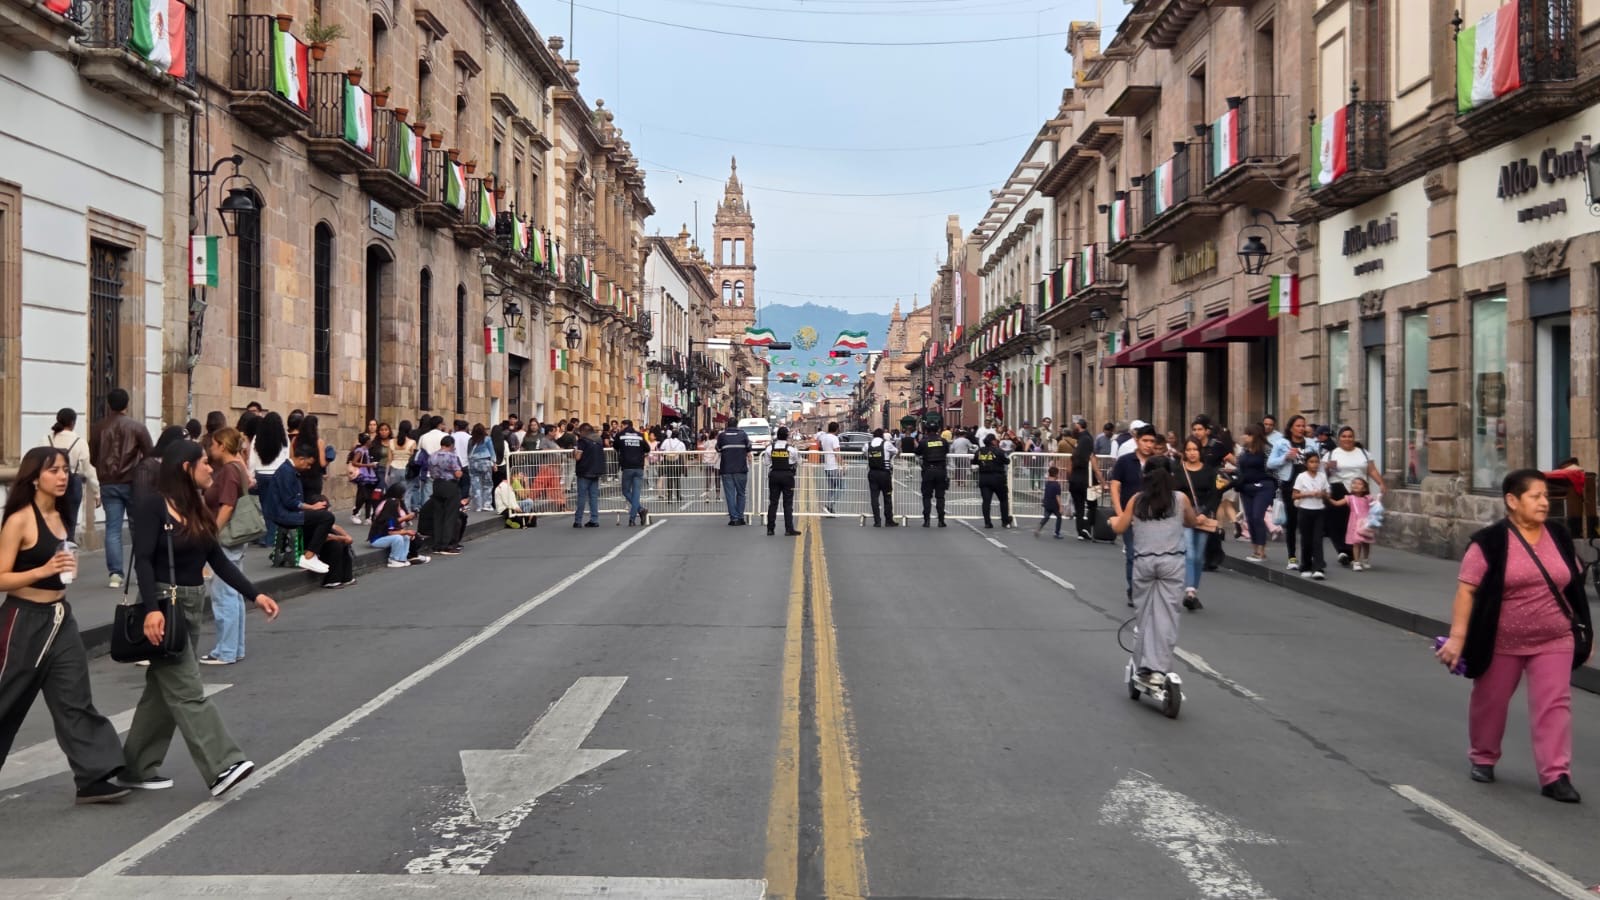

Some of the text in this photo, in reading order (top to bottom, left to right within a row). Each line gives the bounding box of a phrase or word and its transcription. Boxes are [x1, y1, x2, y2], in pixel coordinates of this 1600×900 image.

[1497, 135, 1592, 198] Aldo Conti
[1342, 212, 1398, 256] Aldo Conti
